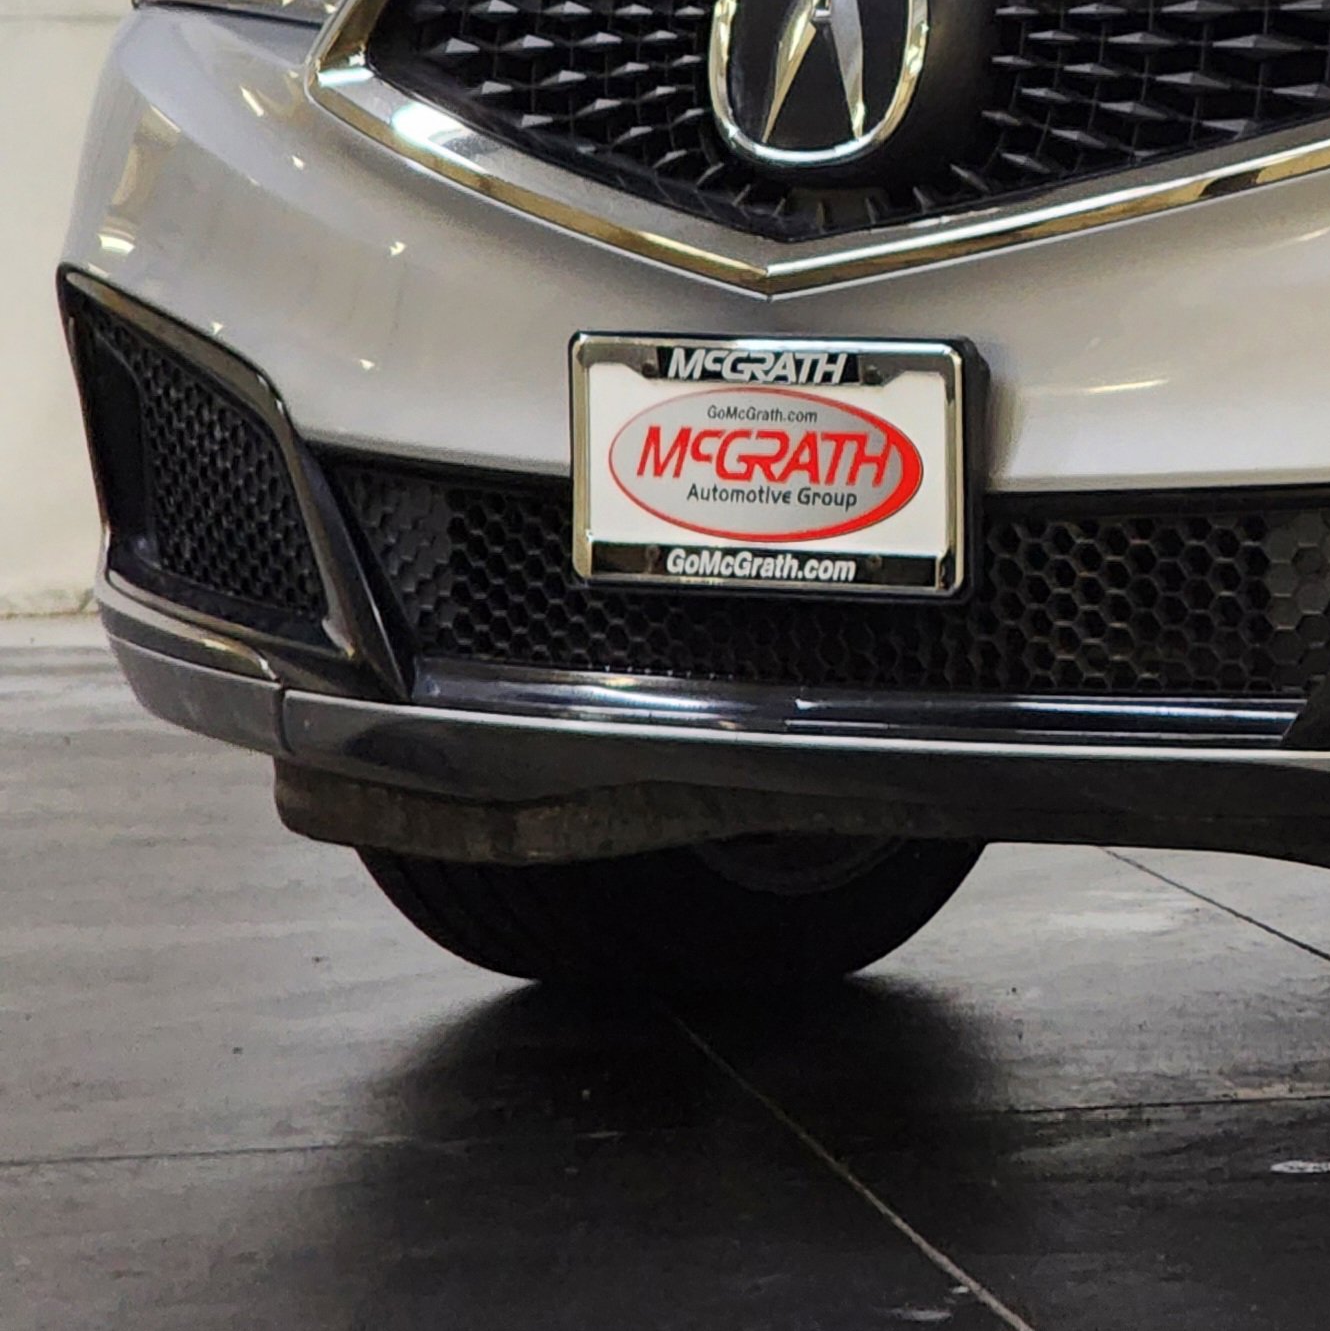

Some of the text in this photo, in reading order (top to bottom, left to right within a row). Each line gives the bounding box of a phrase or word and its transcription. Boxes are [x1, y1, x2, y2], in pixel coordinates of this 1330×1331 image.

[707, 404, 818, 424] GoMcGrath.com
[686, 483, 857, 511] Automotive Group
[666, 548, 857, 582] GoMcGrath.com
